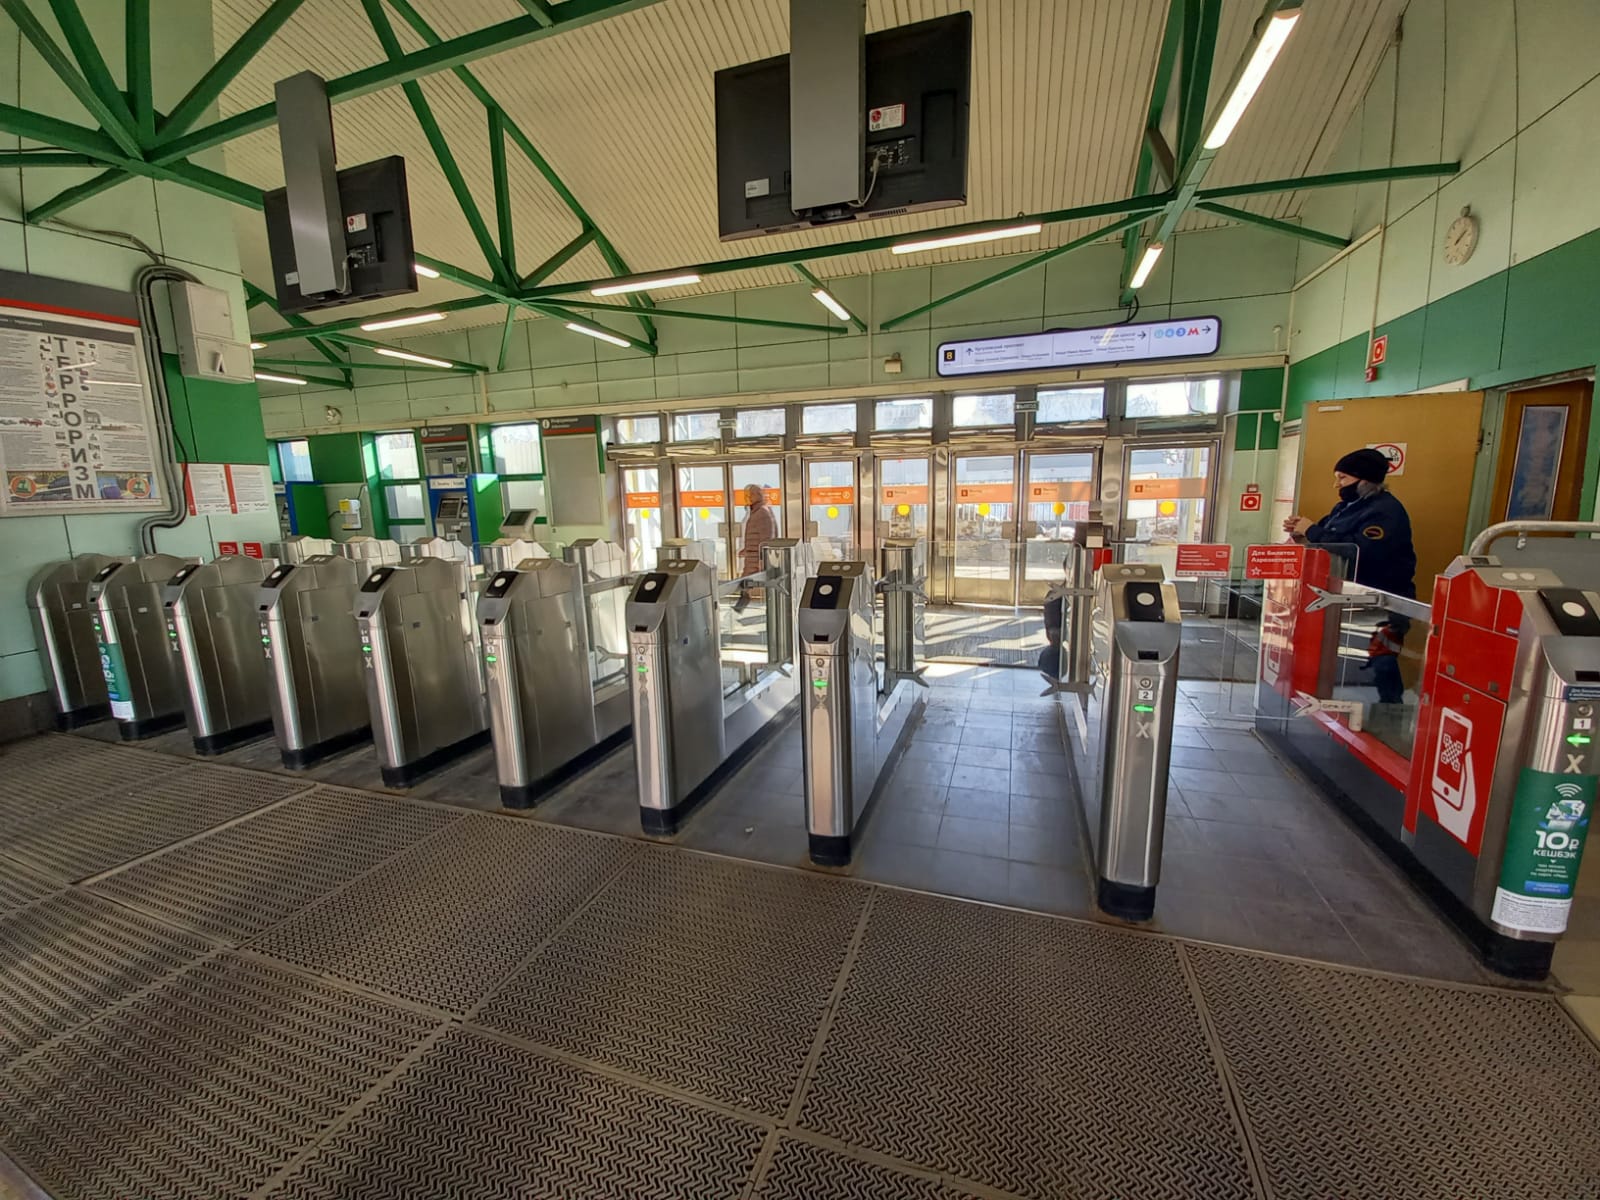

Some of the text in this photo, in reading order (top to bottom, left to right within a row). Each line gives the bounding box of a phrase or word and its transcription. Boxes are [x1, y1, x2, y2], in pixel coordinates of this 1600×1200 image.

[53, 336, 95, 499] ТЕРРОРИЗМ
[1142, 691, 1149, 699] 2
[1579, 719, 1585, 728] 1
[1533, 849, 1577, 859] КЕШБЭК
